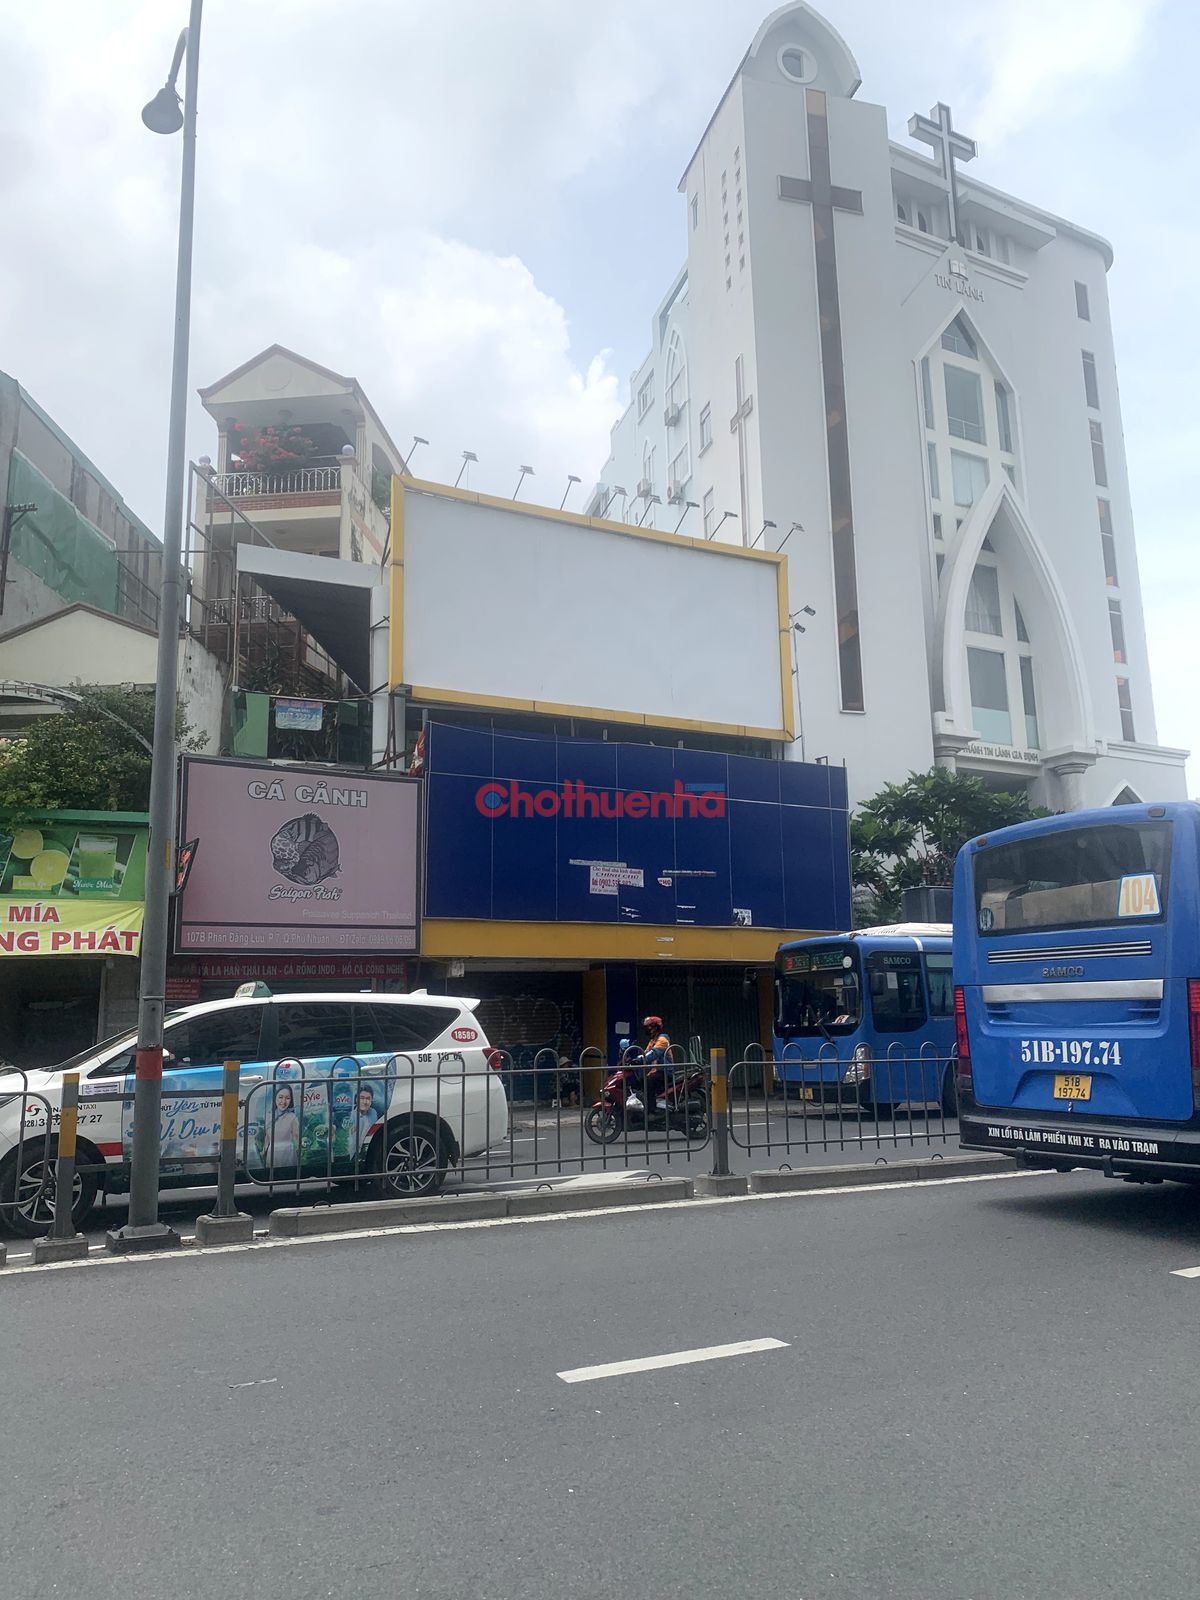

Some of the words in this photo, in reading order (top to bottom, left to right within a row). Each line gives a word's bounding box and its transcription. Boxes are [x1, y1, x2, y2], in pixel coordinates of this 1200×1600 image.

[248, 779, 286, 801] CÁ
[295, 781, 368, 807] CẢNH
[268, 884, 312, 903] Saigon
[313, 885, 340, 900] Fish
[1123, 878, 1155, 914] 104
[9, 903, 60, 922] MÍA
[51, 926, 140, 952] PHÁT
[883, 957, 912, 965] SAMCO
[1042, 966, 1085, 977] SAMCO
[454, 1031, 476, 1040] 18589
[418, 1053, 432, 1062] 50E
[1021, 1040, 1122, 1066] 51B-197.74
[1064, 1077, 1080, 1087] 51B
[1058, 1087, 1086, 1098] 197.74
[89, 1114, 103, 1124] 27
[988, 1126, 1000, 1138] XIN
[1025, 1129, 1041, 1142] LÀM
[1067, 1135, 1081, 1146] KHI
[1083, 1136, 1094, 1148] XE
[1099, 1138, 1111, 1150] RA
[1112, 1137, 1130, 1151] VÀO
[1131, 1141, 1159, 1155] TRẠM
